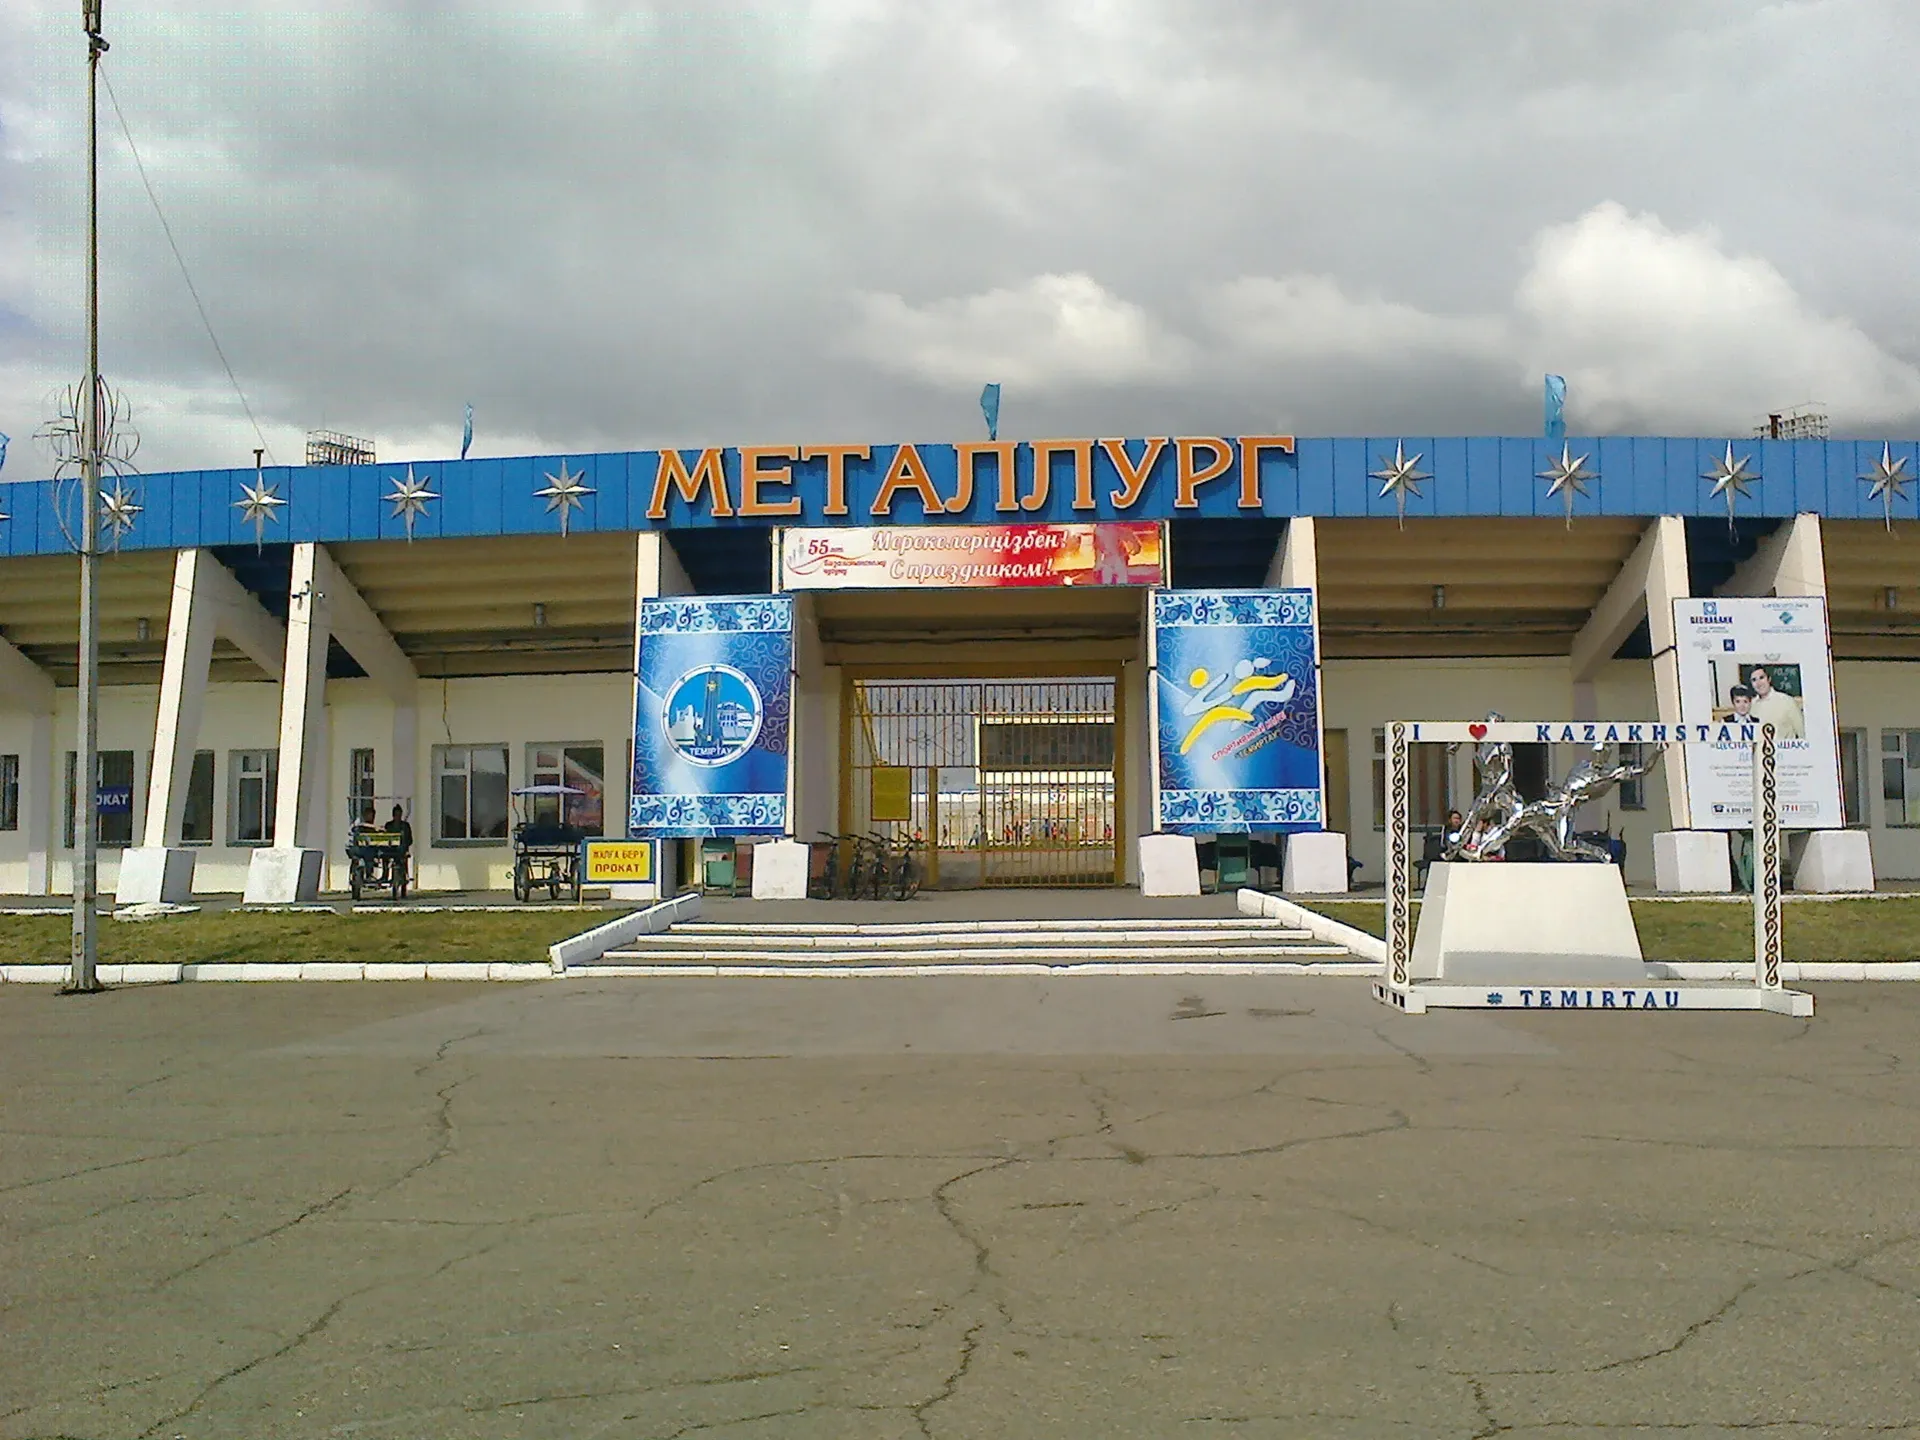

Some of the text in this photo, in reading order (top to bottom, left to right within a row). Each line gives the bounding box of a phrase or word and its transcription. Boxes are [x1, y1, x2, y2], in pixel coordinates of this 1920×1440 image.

[646, 435, 1295, 518] МЕТАЛЛУРГ
[808, 539, 829, 555] 55
[889, 557, 1056, 584] С праздником!
[1413, 724, 1755, 741] I KAZAKHSTAN
[595, 863, 640, 873] ПРОКАТ
[1520, 990, 1679, 1008] TEMIRTAU
